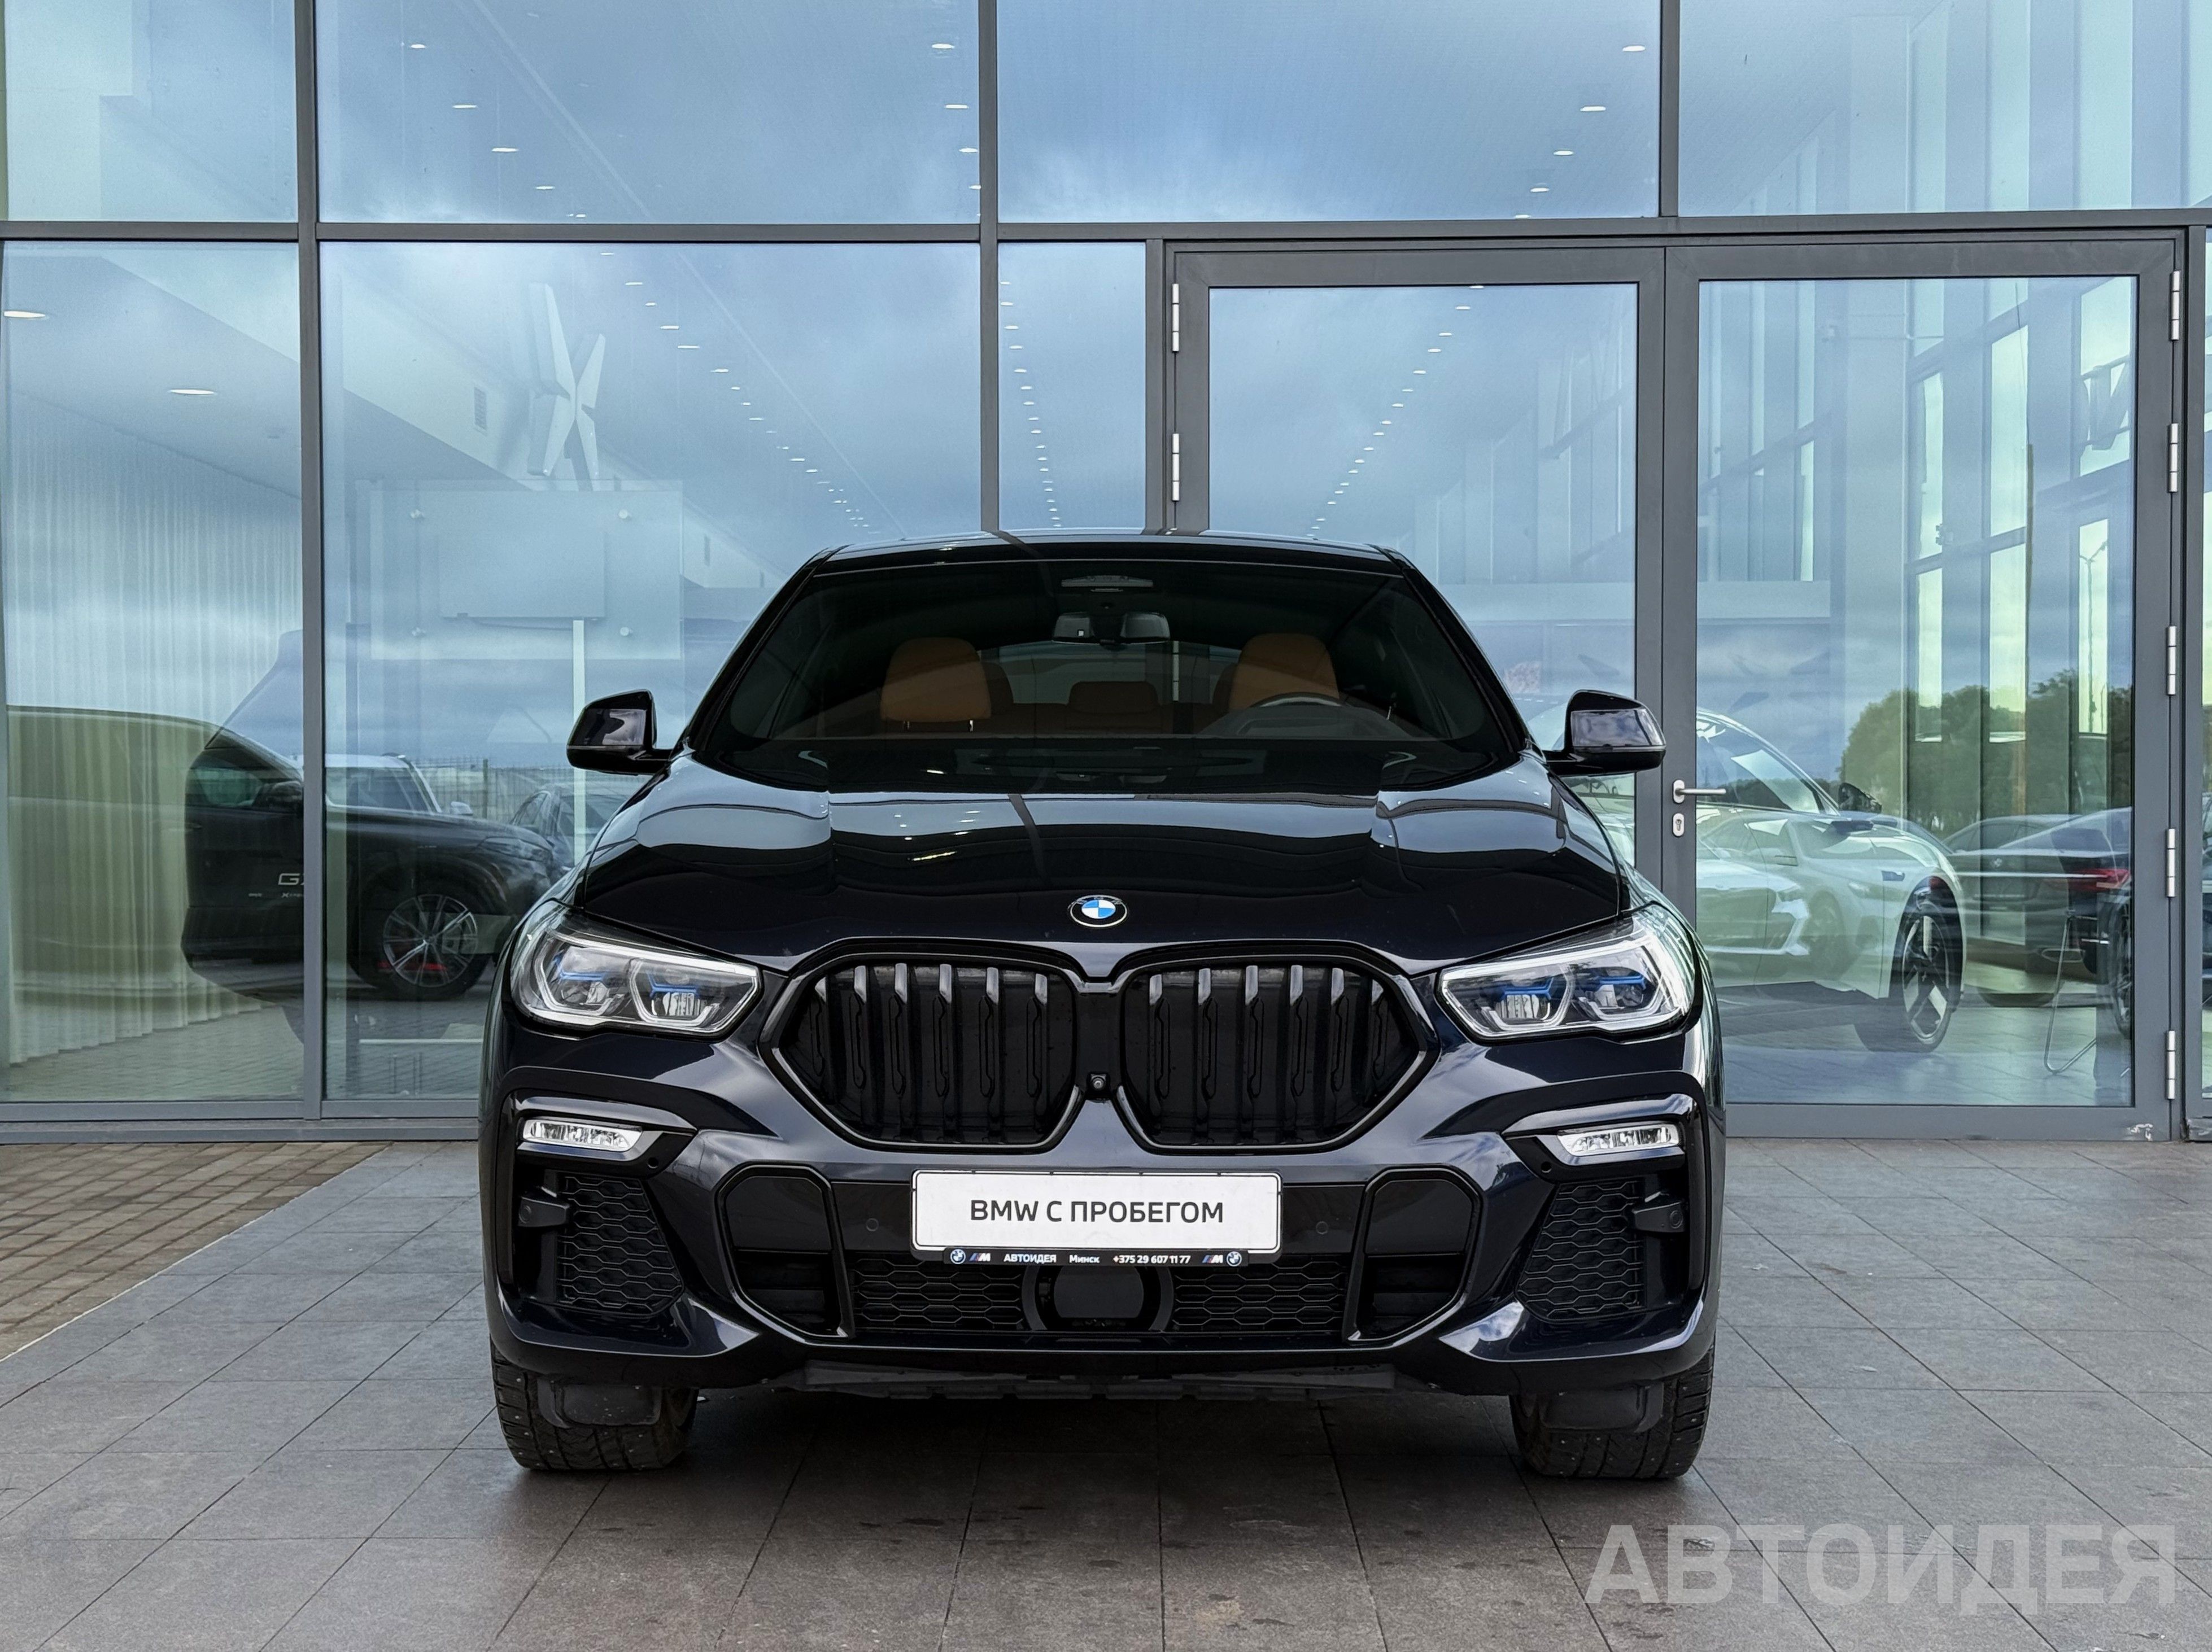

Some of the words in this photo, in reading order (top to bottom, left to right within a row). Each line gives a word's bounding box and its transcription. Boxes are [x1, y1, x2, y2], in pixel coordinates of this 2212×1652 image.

[971, 1200, 1039, 1221] BMW
[1046, 1200, 1062, 1222] С
[1071, 1201, 1223, 1223] ПРОБЕГОМ
[1003, 1253, 1057, 1264] АВТОИДЕЯ
[1069, 1254, 1100, 1264] Минск
[1112, 1255, 1136, 1264] +375
[1137, 1255, 1149, 1264] 29
[1150, 1255, 1169, 1264] 607
[1169, 1255, 1178, 1264] 11
[1179, 1255, 1191, 1264] 77
